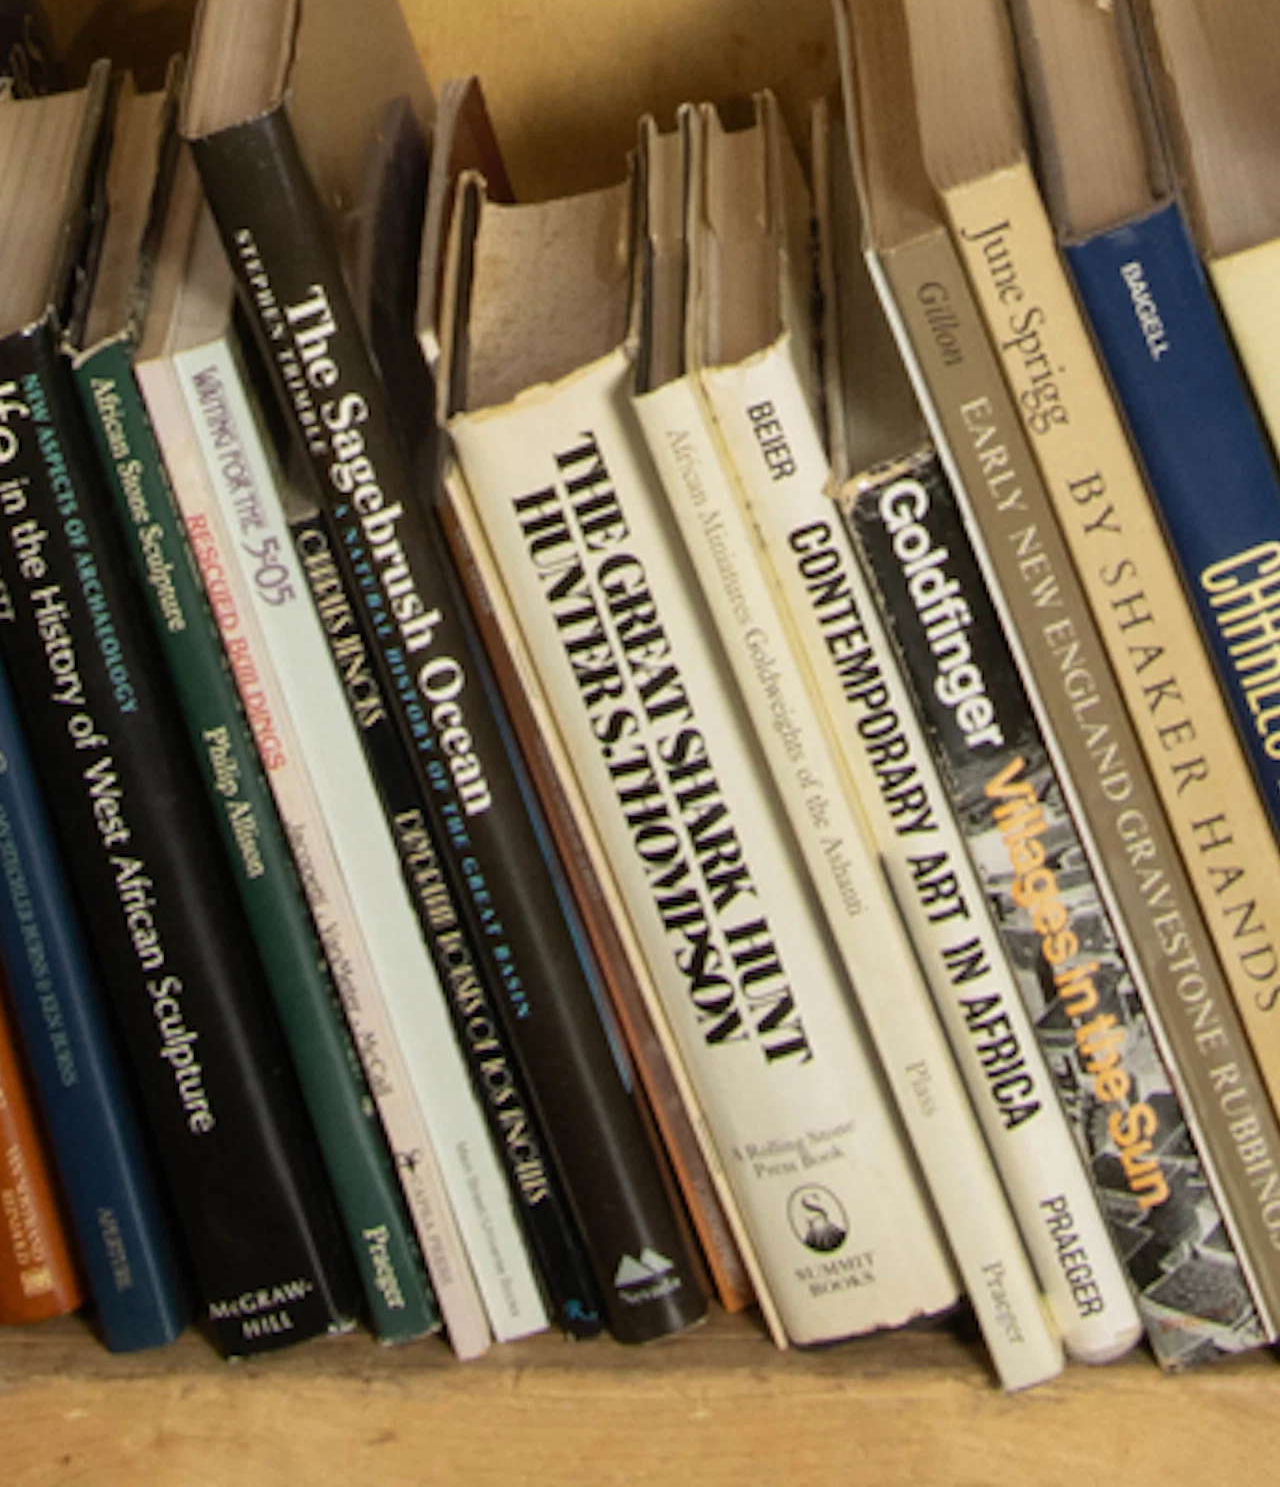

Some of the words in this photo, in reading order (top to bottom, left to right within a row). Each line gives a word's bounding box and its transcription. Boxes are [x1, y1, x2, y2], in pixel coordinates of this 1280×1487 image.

[959, 212, 1036, 311] June
[1117, 260, 1173, 362] BAIGELL
[231, 228, 288, 342] STEPHEN
[274, 347, 331, 458] TRIMBLE
[279, 282, 354, 391] The
[992, 303, 1085, 437] Sprigg
[745, 398, 796, 482] BEIER
[9, 516, 57, 579] the
[305, 389, 451, 658] Sagebrush
[20, 581, 95, 709] History
[508, 483, 631, 713] HUNTER
[864, 468, 1015, 765] Goldfinger
[1064, 470, 1122, 544] BY
[1096, 556, 1215, 795] SHAKER
[64, 710, 110, 752] of
[410, 653, 510, 817] Ocean
[784, 516, 939, 843] CONTEMPORARY
[958, 393, 1029, 521] EARLY
[1007, 522, 1064, 616] NEW
[1041, 616, 1135, 806] ENGLAND
[1111, 805, 1228, 1055] GRAVESTONE
[78, 754, 137, 848] West
[547, 428, 632, 554] THE
[590, 549, 697, 735] GREAT
[653, 725, 760, 911] SHARK
[719, 916, 817, 1073] HUNT
[107, 849, 174, 971] African
[904, 845, 971, 929] ART
[970, 754, 1092, 972] Villages
[939, 937, 992, 985] IN
[1052, 957, 1112, 1018] in
[138, 971, 224, 1138] Sculpture
[957, 988, 1047, 1131] AFRICA
[1069, 1004, 1145, 1108] the
[1103, 1095, 1185, 1211] Sun
[1038, 1193, 1107, 1319] PRAEGER
